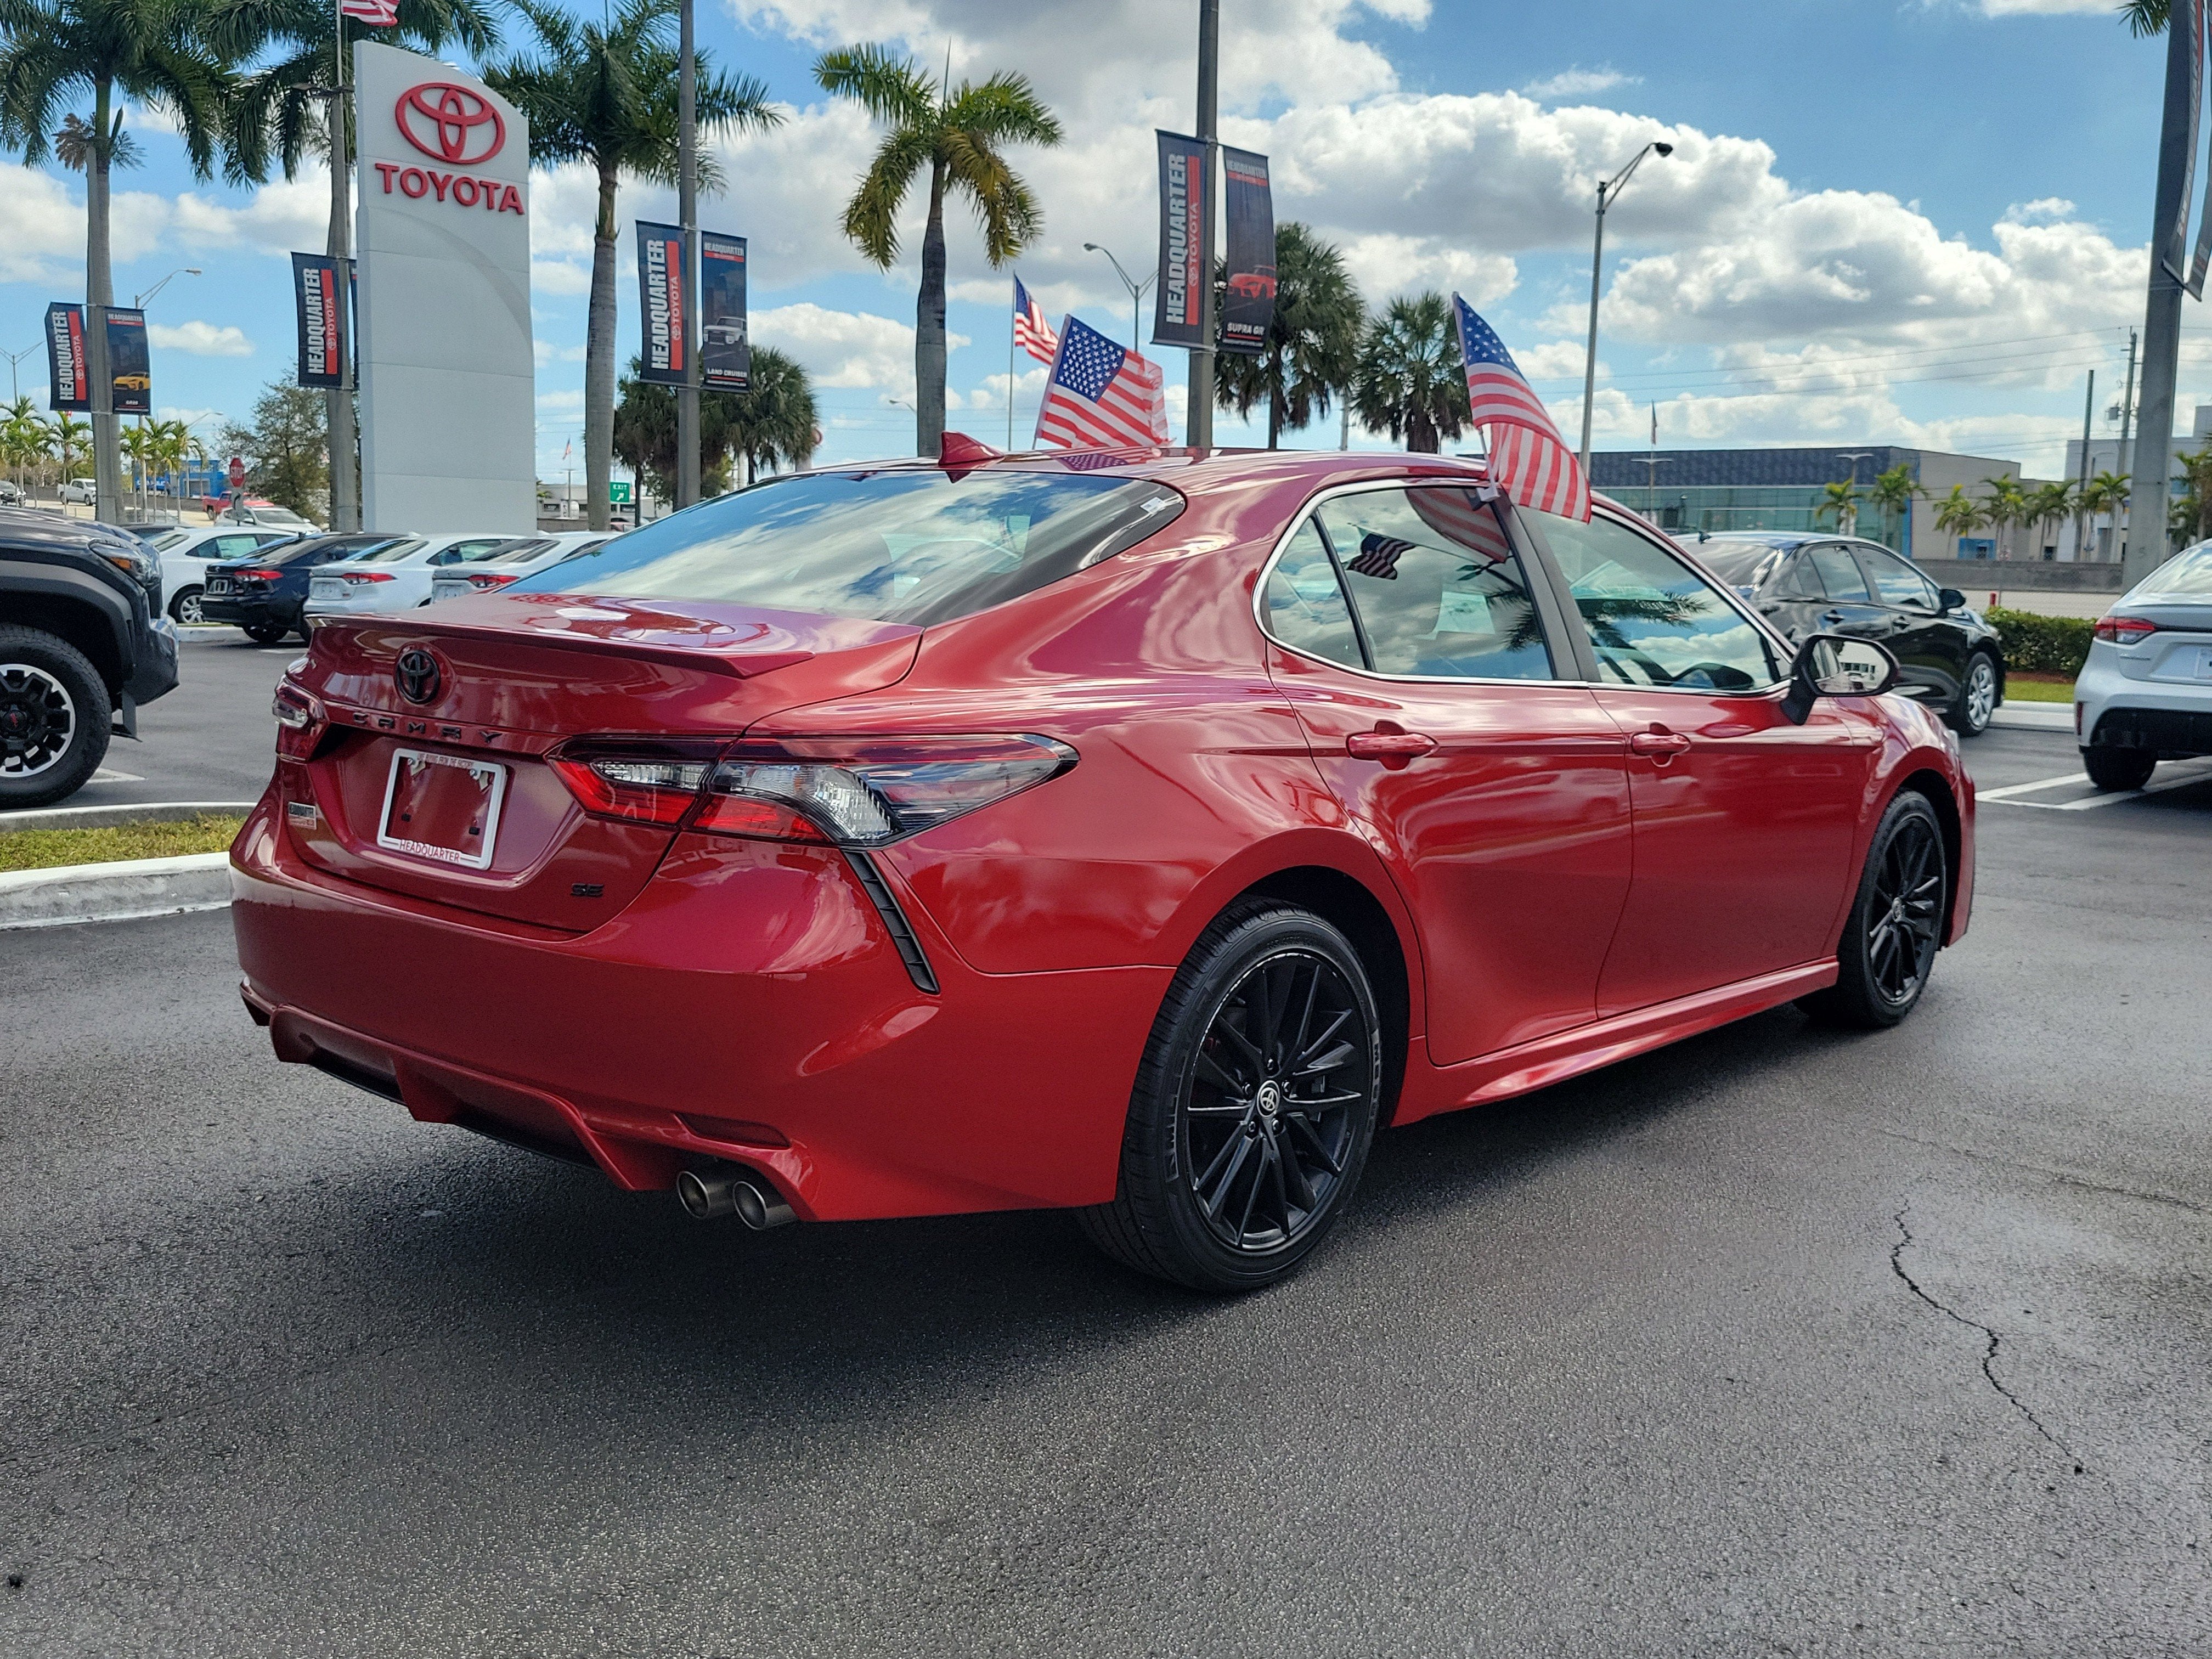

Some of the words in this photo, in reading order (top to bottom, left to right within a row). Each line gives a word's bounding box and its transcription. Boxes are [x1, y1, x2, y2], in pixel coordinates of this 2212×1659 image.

[375, 162, 525, 215] TOYOTA
[1166, 153, 1188, 325] HEADQUARTER
[1188, 202, 1198, 266] TOYOTA
[326, 297, 336, 336] TOYOTA
[647, 240, 670, 370] HEADQUARTER
[670, 276, 681, 325] TOYOTA
[303, 268, 326, 374] HEADQUARTER
[1227, 322, 1252, 335] SUPRA
[1253, 325, 1265, 336] GR
[52, 312, 75, 400] HEADQUARTER
[74, 335, 82, 369] TOYOTA
[724, 369, 747, 377] CRUISER
[230, 466, 245, 478] STOP
[353, 712, 503, 743] CAMRY
[399, 839, 460, 863] HEADQUARTER
[570, 883, 604, 896] SE
